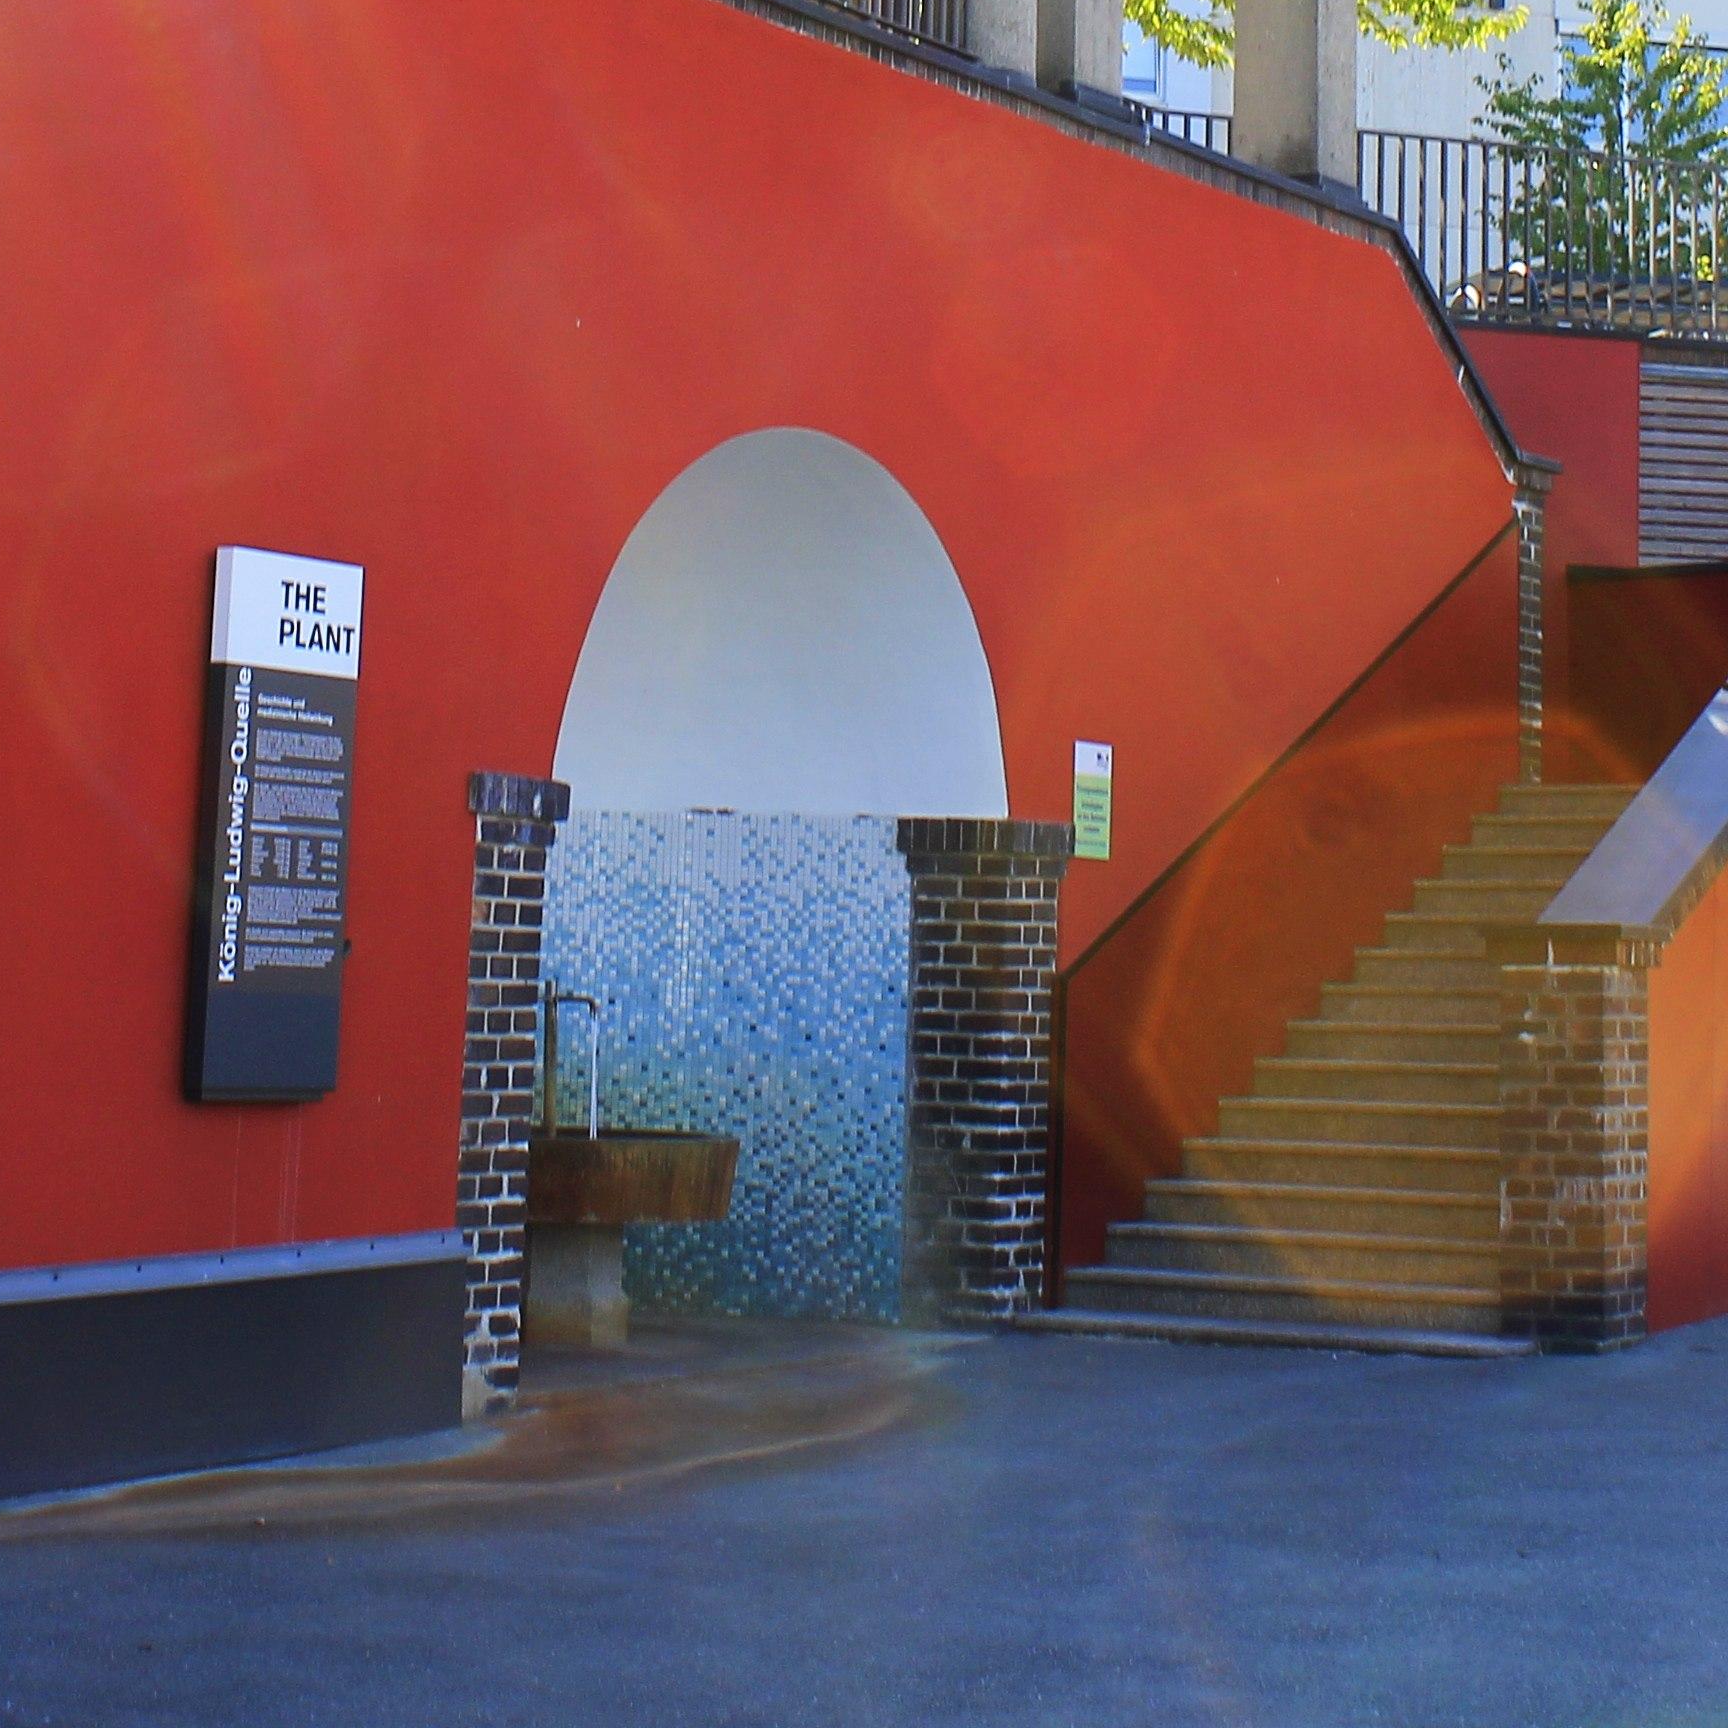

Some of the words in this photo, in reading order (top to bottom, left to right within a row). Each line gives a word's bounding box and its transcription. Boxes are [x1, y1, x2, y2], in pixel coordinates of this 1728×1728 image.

[281, 580, 327, 615] THE
[278, 618, 355, 655] PLANT
[218, 666, 252, 982] König-Ludwig-Quelle
